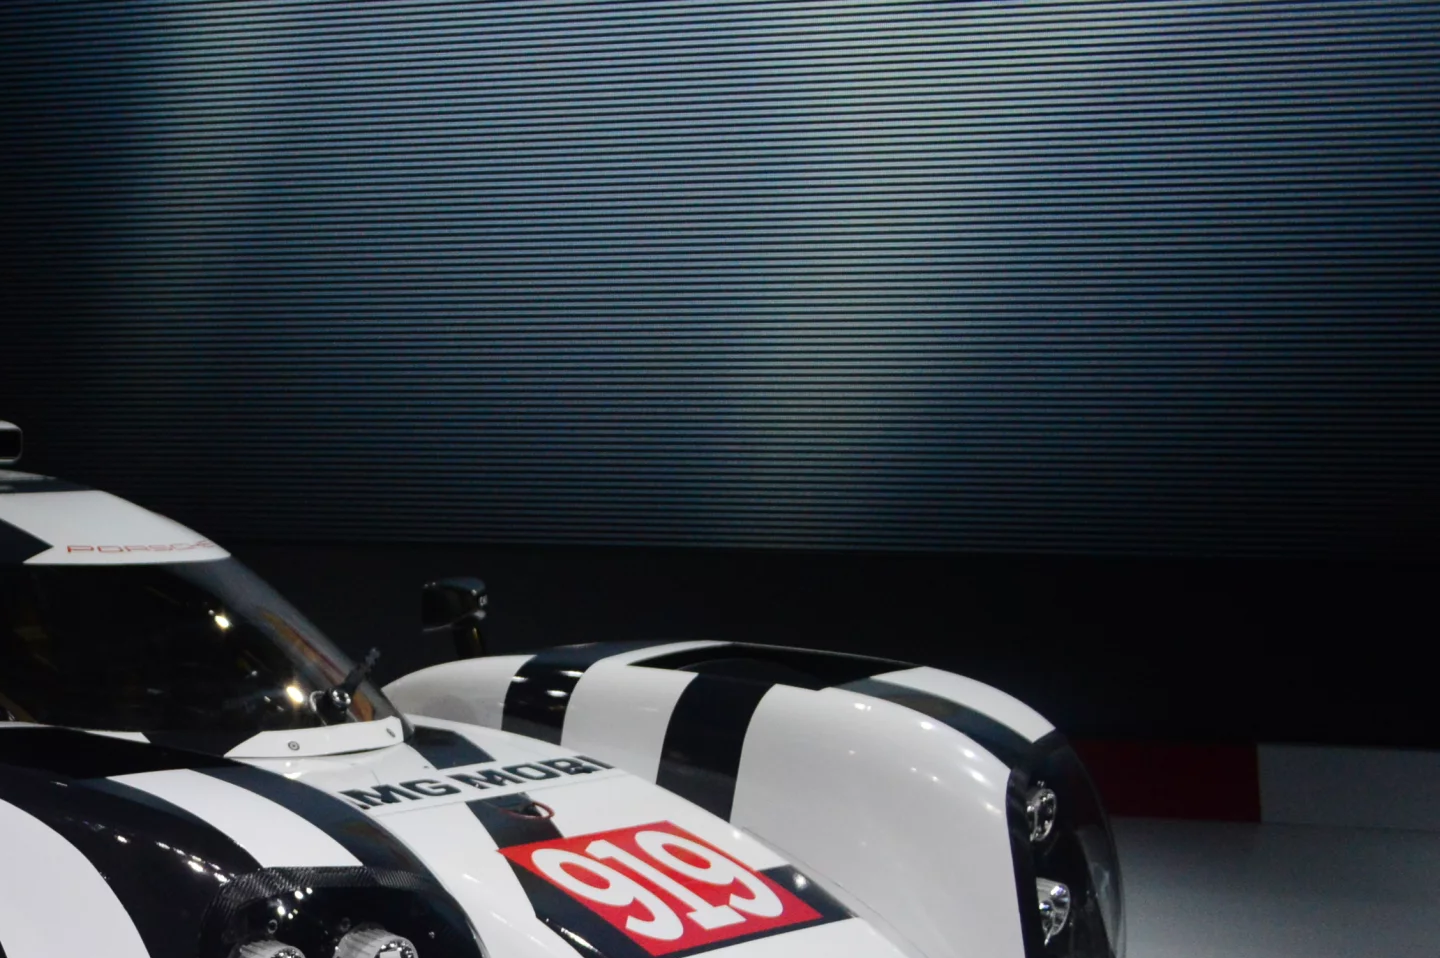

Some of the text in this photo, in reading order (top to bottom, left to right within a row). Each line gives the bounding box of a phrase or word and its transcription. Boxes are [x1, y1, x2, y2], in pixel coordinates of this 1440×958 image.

[67, 540, 216, 553] PORSCHE
[338, 755, 616, 810] MG MORI
[531, 830, 784, 941] 919
